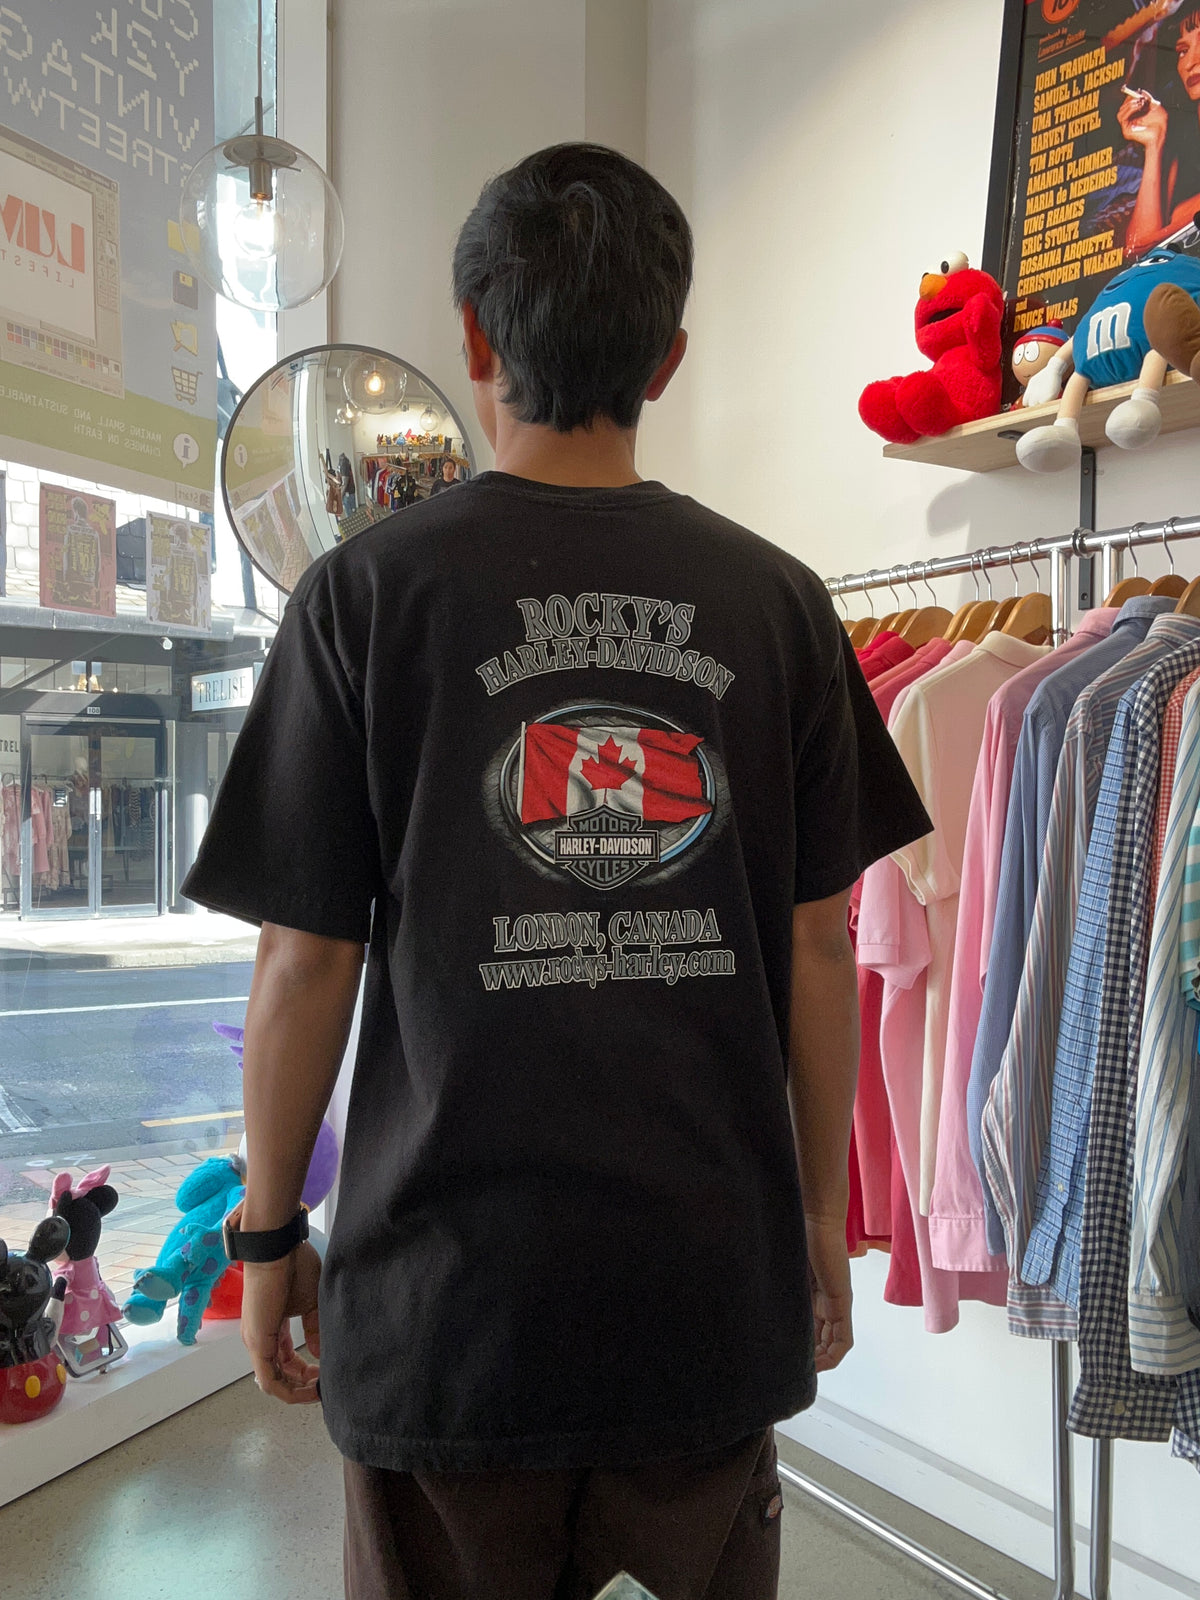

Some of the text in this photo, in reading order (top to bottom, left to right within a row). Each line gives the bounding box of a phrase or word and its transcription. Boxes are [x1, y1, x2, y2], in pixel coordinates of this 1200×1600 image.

[1033, 58, 1125, 114] SAMUEL L. JACKSON
[1034, 46, 1106, 94] JOHN TRAVOLTA
[1030, 110, 1102, 155] HARVEY KEITEL
[1032, 90, 1100, 134] UMA THURMAN
[1026, 146, 1113, 196] AMANDA PLUMMER
[1029, 141, 1074, 174] TIM ROTH
[1025, 165, 1118, 216] MARIA de MEDEIROS
[1021, 220, 1080, 258] ERIC STOLTZ
[1023, 198, 1085, 236] VING RHAMES
[1016, 247, 1124, 298] CHRISTOPHER WALKEN
[1018, 229, 1115, 278] ROSANNA ARQUETTE
[1013, 297, 1079, 333] BRUCE WILLIS
[516, 592, 696, 646] ROCKY'S
[475, 636, 736, 701] HARLEY-DAVIDSON
[559, 837, 653, 855] HARLEY-DAVIDSON
[579, 815, 630, 833] MOTOR
[579, 860, 631, 882] CYCLES
[492, 908, 722, 954] LONDON, CANADA
[479, 946, 736, 991] www.rockys-harley.com
